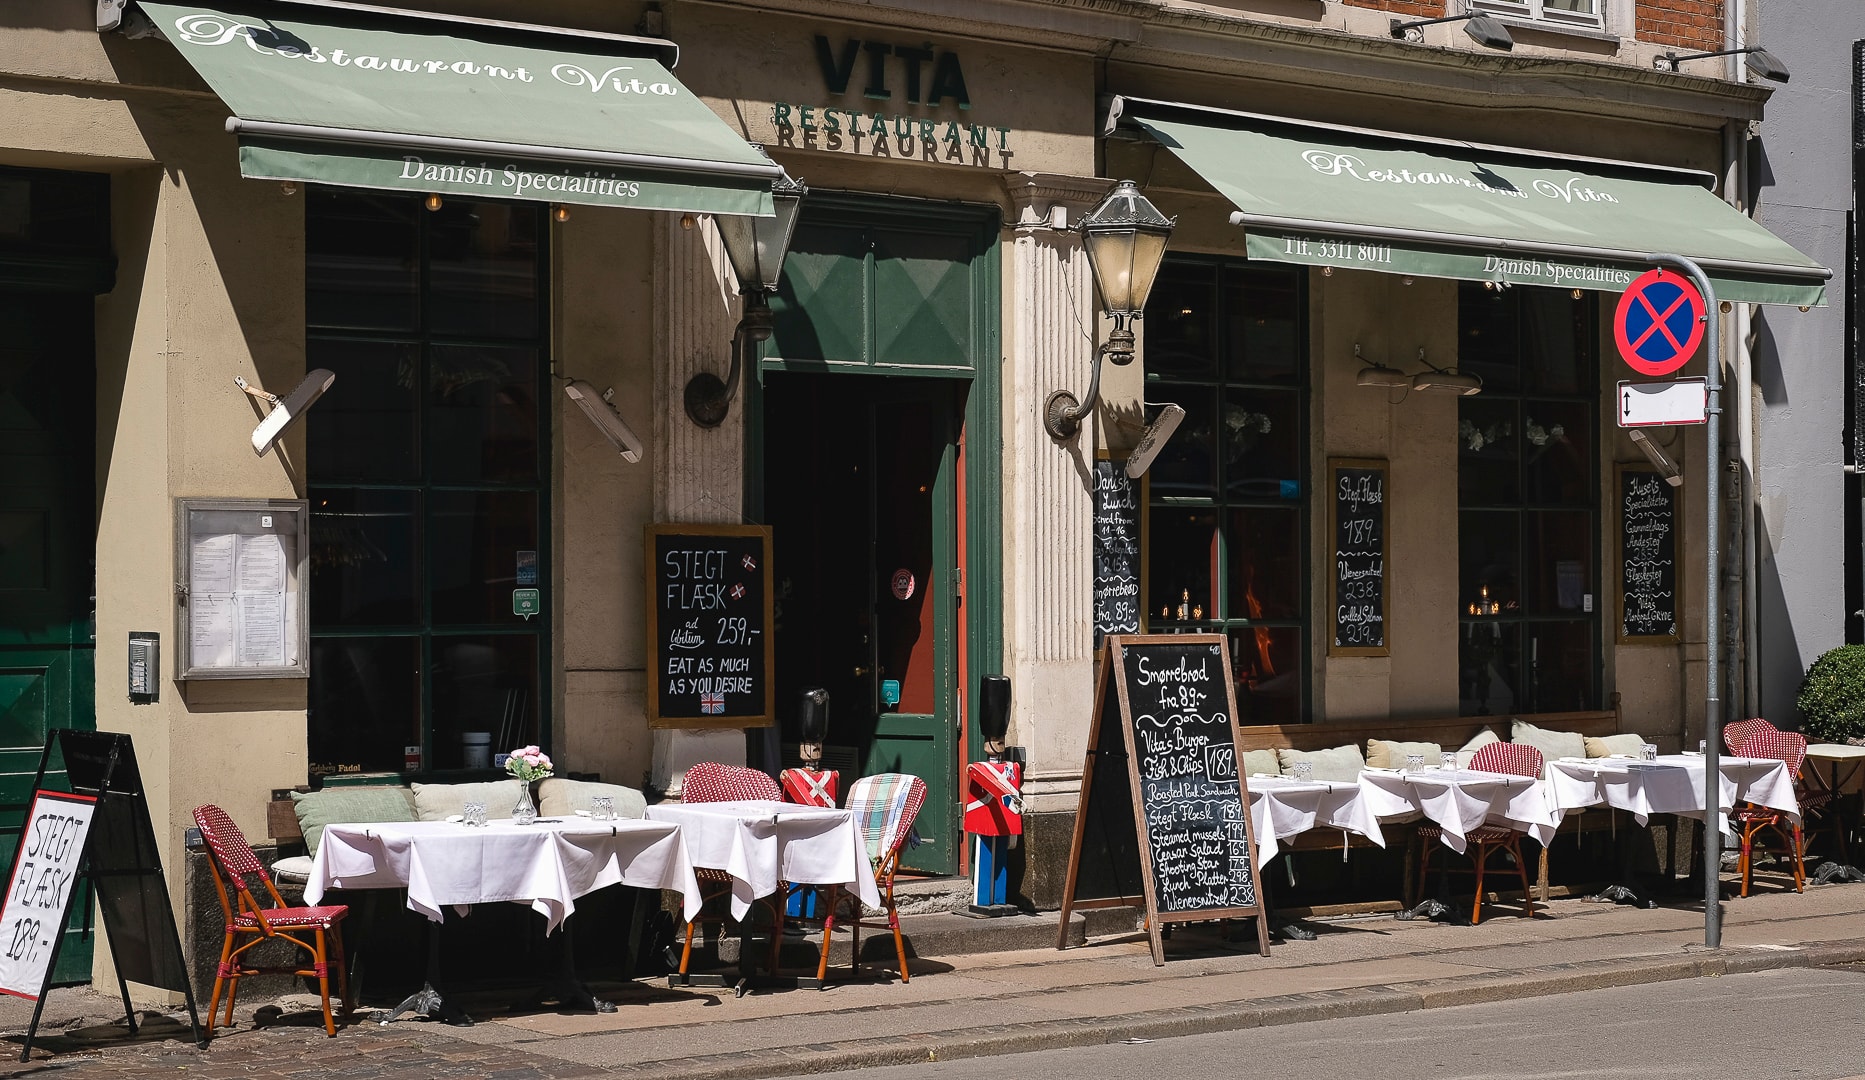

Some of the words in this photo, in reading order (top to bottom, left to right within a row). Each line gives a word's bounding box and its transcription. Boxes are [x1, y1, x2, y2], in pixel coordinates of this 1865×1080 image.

[174, 14, 533, 83] Restaurant
[551, 63, 678, 96] Vita
[814, 34, 972, 111] VITA
[773, 101, 1012, 150] RESTAURANT
[399, 155, 494, 187] Danish
[501, 164, 640, 198] Specialities
[1301, 150, 1529, 200] Restaurant
[1532, 177, 1620, 204] Vita
[1282, 234, 1312, 257] Tlf.
[1318, 237, 1353, 261] 3311
[1357, 240, 1393, 264] 8011
[1483, 254, 1541, 277] Danish
[1545, 257, 1632, 286] Specialities
[1093, 468, 1132, 492] Danish
[1103, 492, 1136, 510] Lunch
[1338, 476, 1361, 512] Stegt
[665, 550, 728, 580] STEGT
[667, 584, 727, 610] FLÆSK
[685, 617, 699, 629] ad
[1338, 605, 1362, 624] Grilled
[1358, 605, 1383, 625] Salmon
[670, 629, 705, 645] libitum
[717, 617, 761, 646] 259,-
[668, 657, 694, 674] EAT
[697, 657, 714, 673] AS
[719, 657, 749, 673] MUCH
[1137, 655, 1210, 686] Smørrebrød
[669, 678, 685, 694] AS
[689, 677, 712, 694] YOU
[715, 677, 753, 694] DESIRE
[1140, 729, 1173, 755] Vita's
[1173, 727, 1210, 757] Burger
[1143, 755, 1170, 780] Fish
[1177, 755, 1204, 781] Chips
[1146, 781, 1184, 803] Roasted
[1183, 782, 1200, 798] Pork
[1200, 783, 1239, 798] Sandwich
[1149, 804, 1178, 831] Stegt
[1180, 804, 1214, 821] Flæsk
[28, 813, 84, 865] STEGT
[1151, 828, 1192, 848] Steamed
[1192, 825, 1226, 841] mussels
[1189, 841, 1224, 858] Salad
[1159, 859, 1197, 879] Shooting
[1196, 857, 1220, 870] Star
[14, 861, 72, 910] FLÆSK
[1161, 875, 1191, 893] Lunch
[1195, 871, 1228, 887] Platter
[1163, 886, 1230, 911] Wienersnitzel
